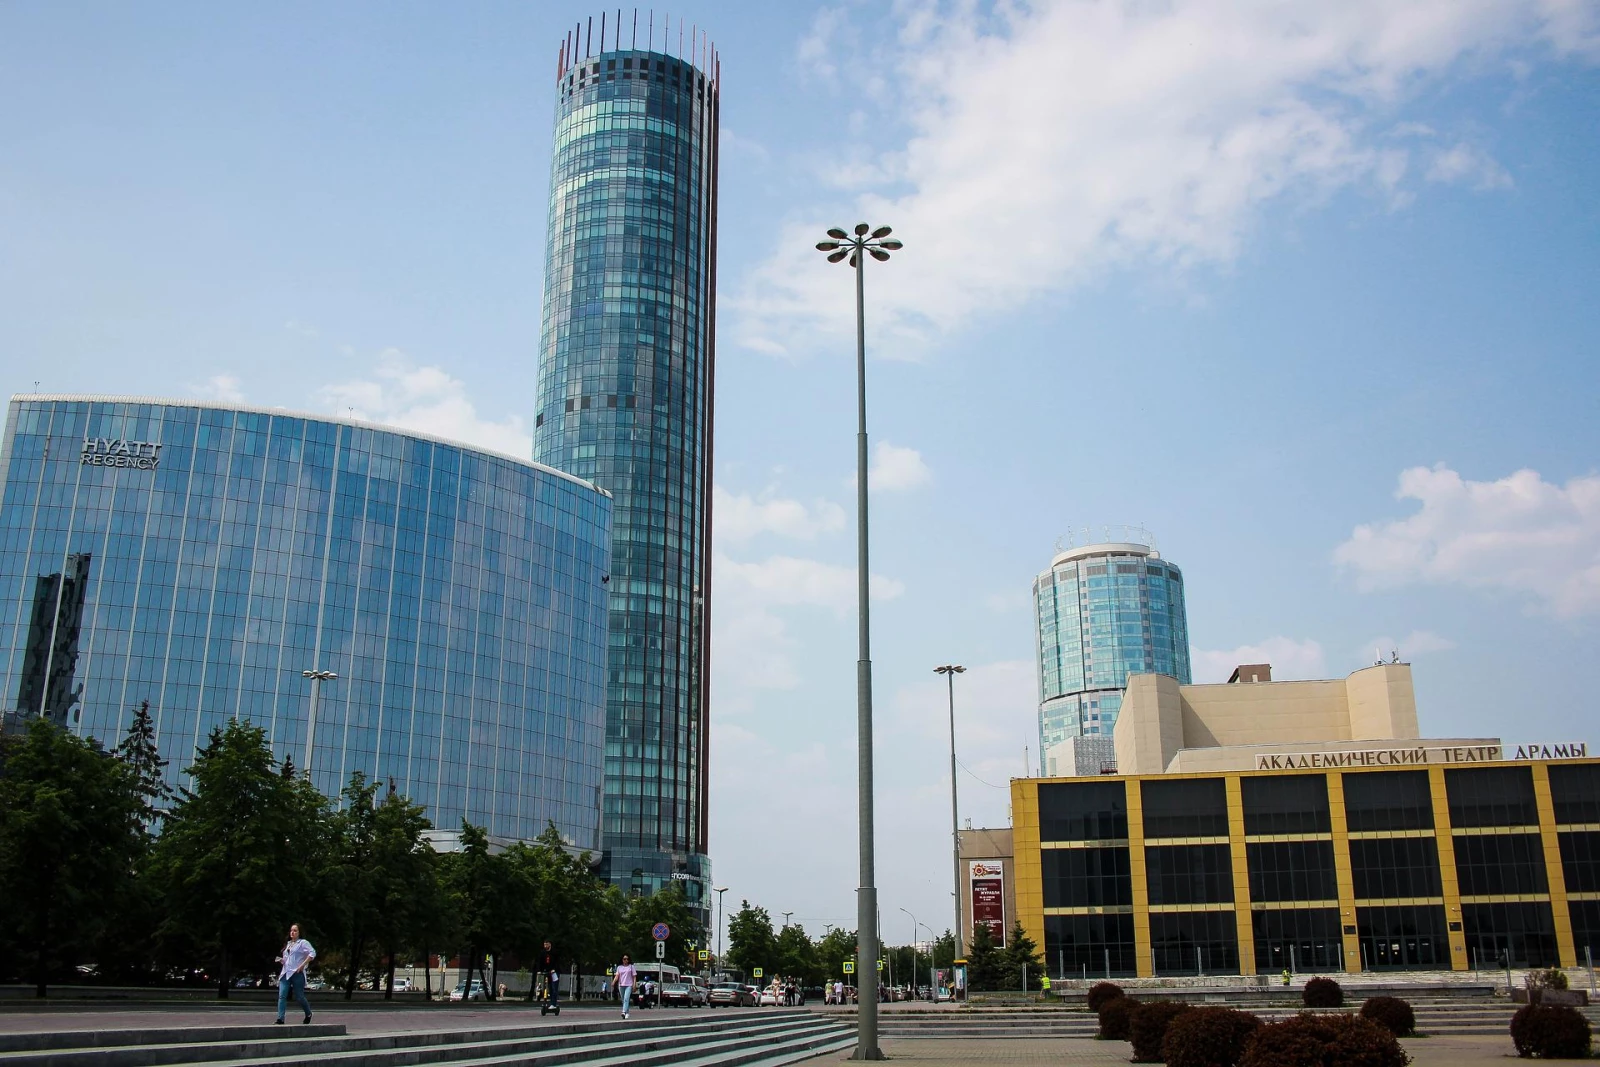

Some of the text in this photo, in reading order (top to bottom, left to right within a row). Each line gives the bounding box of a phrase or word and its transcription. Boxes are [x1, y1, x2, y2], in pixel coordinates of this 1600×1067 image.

[82, 437, 162, 458] HYATT
[81, 453, 160, 470] REGENCY
[1259, 743, 1586, 770] АКАДЕМИЧЕСКИЙ ТЕАТР ДРАМЫ
